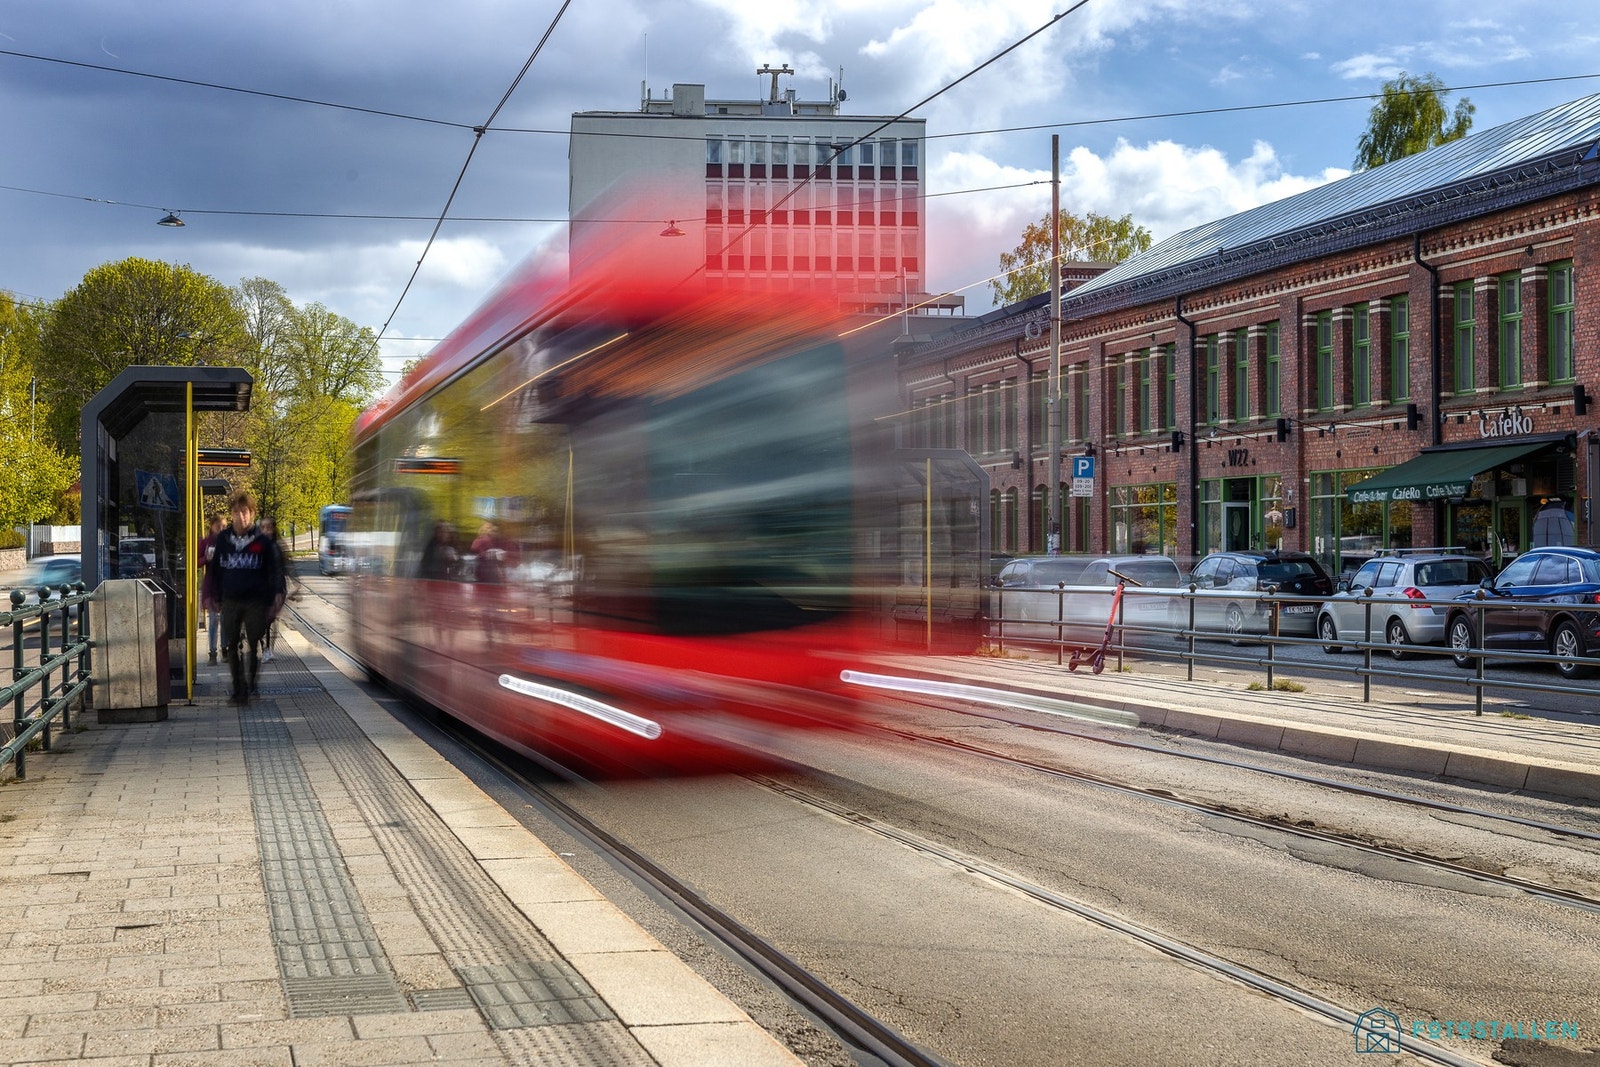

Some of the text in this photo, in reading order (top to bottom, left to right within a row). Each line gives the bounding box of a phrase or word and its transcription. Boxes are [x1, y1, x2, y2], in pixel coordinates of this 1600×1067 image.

[1228, 449, 1249, 467] W22
[1078, 459, 1090, 476] P
[1392, 486, 1421, 500] CafeRo
